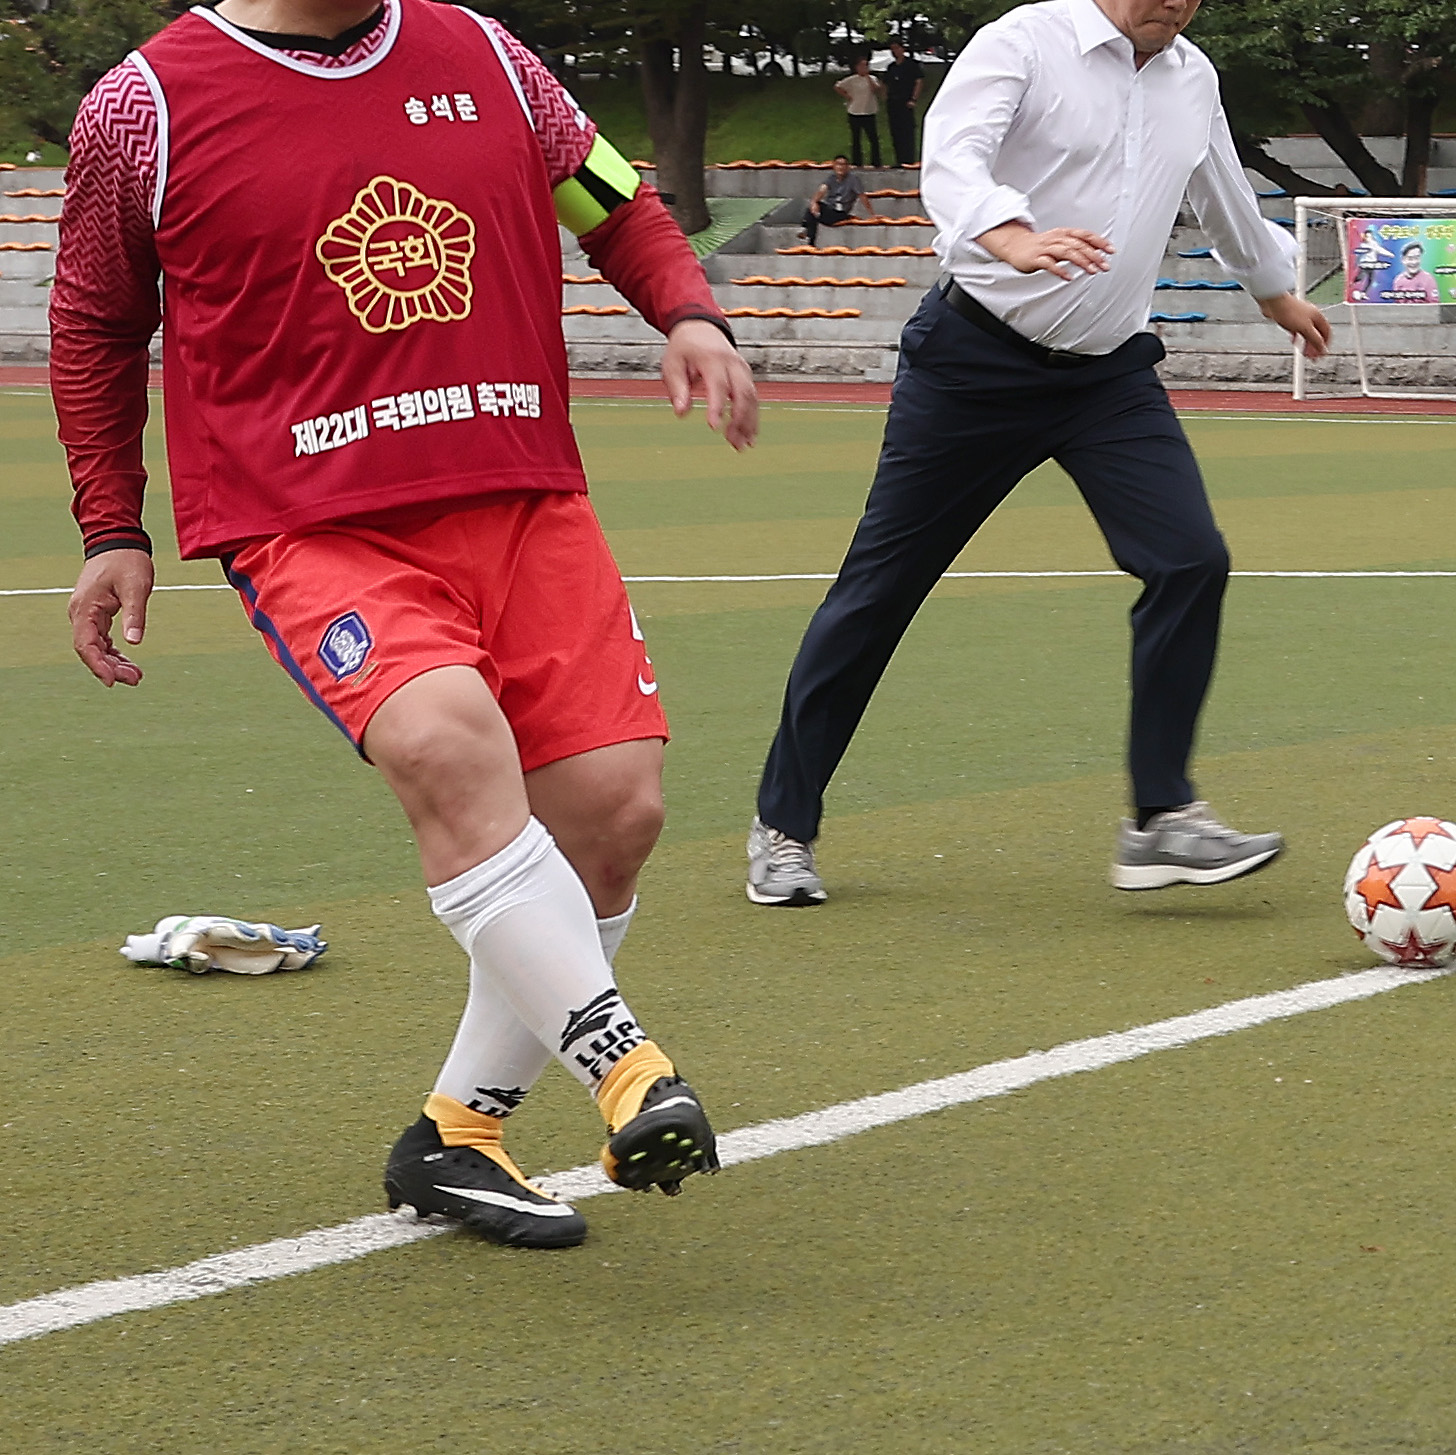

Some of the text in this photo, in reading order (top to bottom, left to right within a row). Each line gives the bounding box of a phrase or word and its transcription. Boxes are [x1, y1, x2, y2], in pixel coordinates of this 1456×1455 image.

[404, 93, 479, 125] 송석준
[368, 234, 439, 277] 국회
[291, 382, 541, 457] 제22대 국회의원 축구연맹
